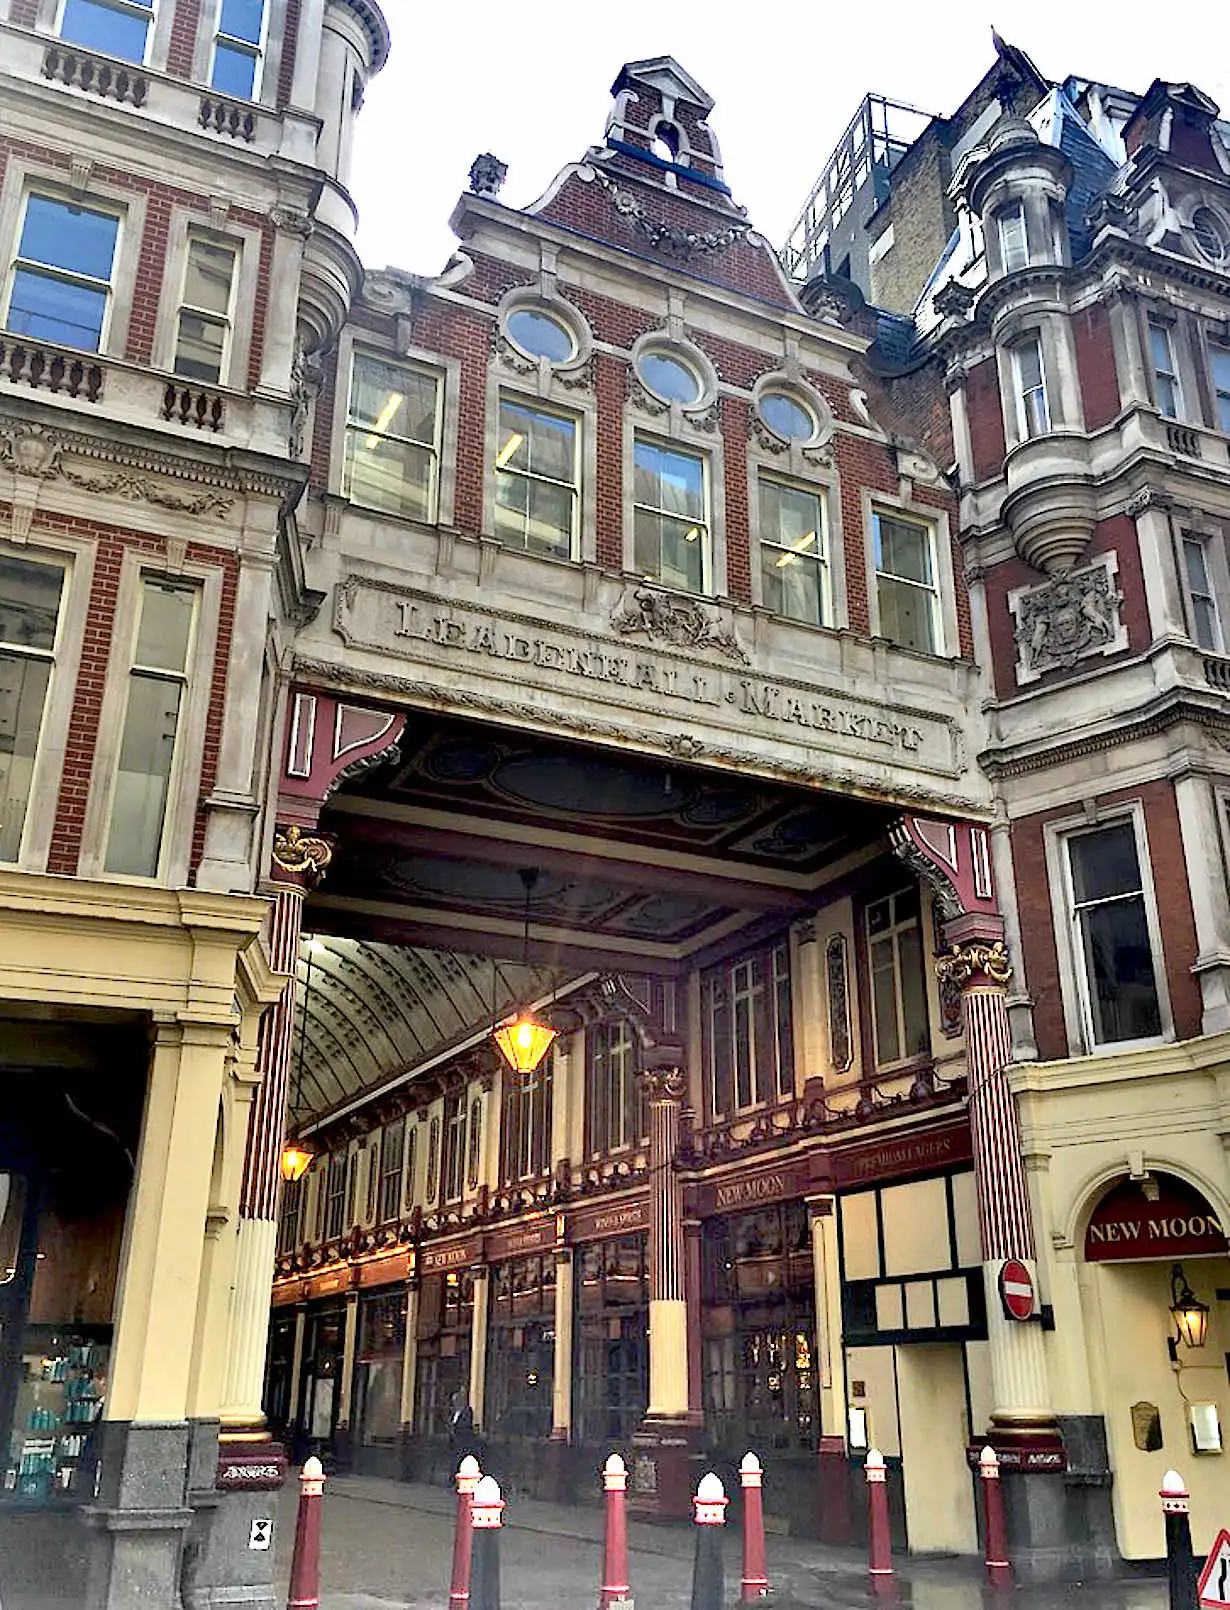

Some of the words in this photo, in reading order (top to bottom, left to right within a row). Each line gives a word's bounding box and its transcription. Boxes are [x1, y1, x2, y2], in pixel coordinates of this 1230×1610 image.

[394, 601, 721, 708] LEADENHALL
[740, 679, 924, 752] MARKET
[717, 1186, 741, 1207] NEW
[744, 1175, 784, 1201] MOON
[1089, 1221, 1141, 1243] NEW
[1147, 1215, 1224, 1239] MOON
